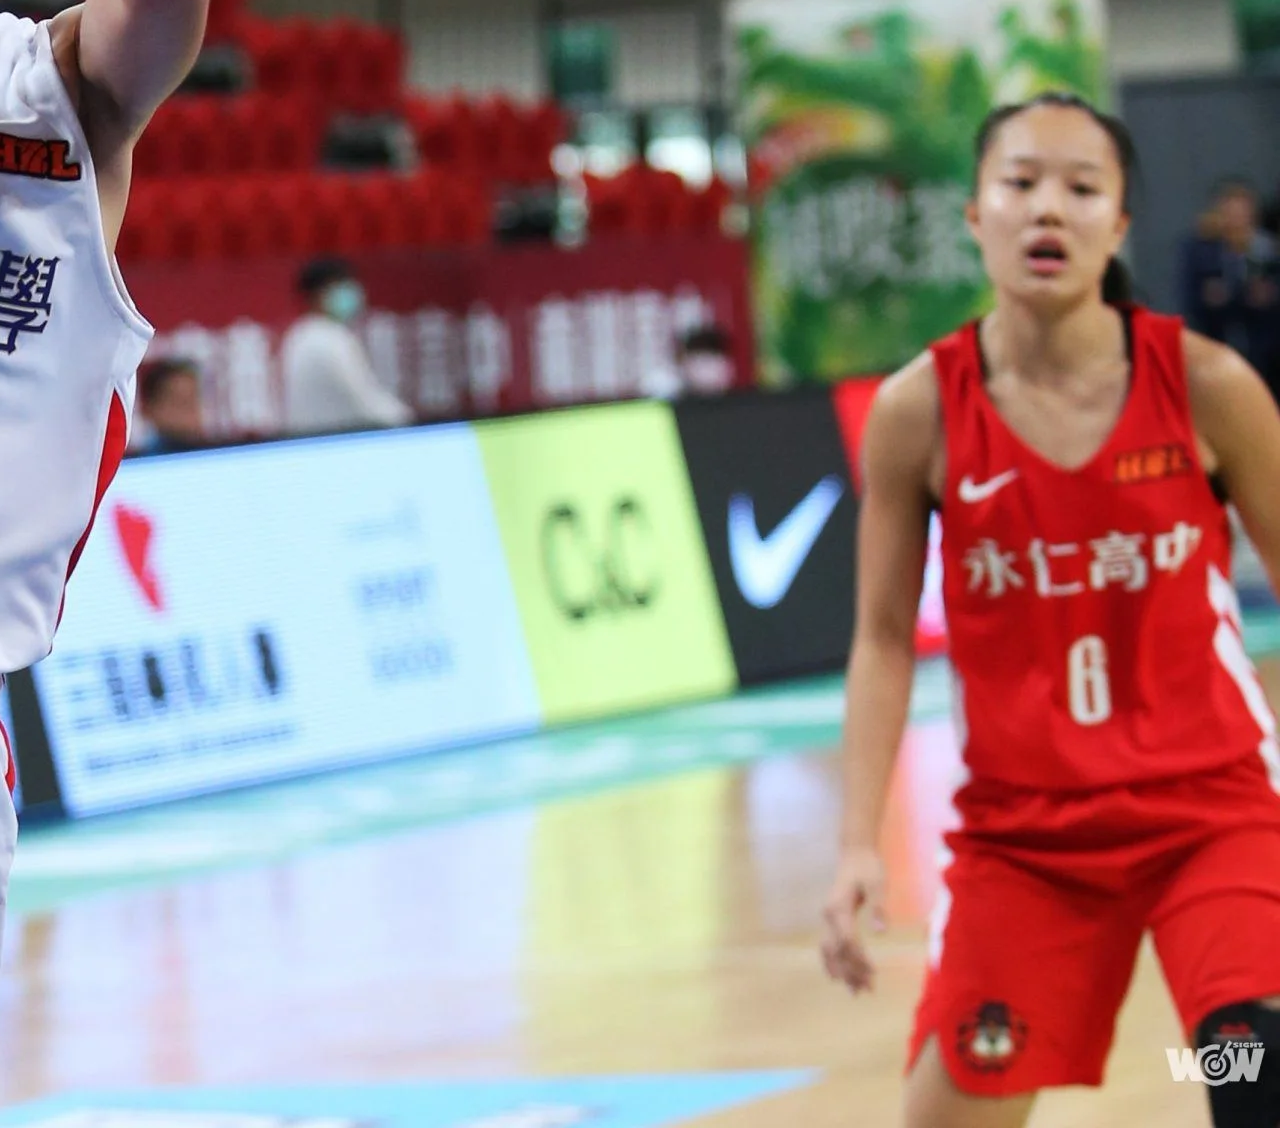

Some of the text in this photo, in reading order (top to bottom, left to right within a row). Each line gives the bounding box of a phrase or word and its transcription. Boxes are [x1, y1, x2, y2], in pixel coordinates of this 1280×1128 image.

[965, 521, 1203, 599] 永仁高中
[1069, 635, 1112, 725] 6
